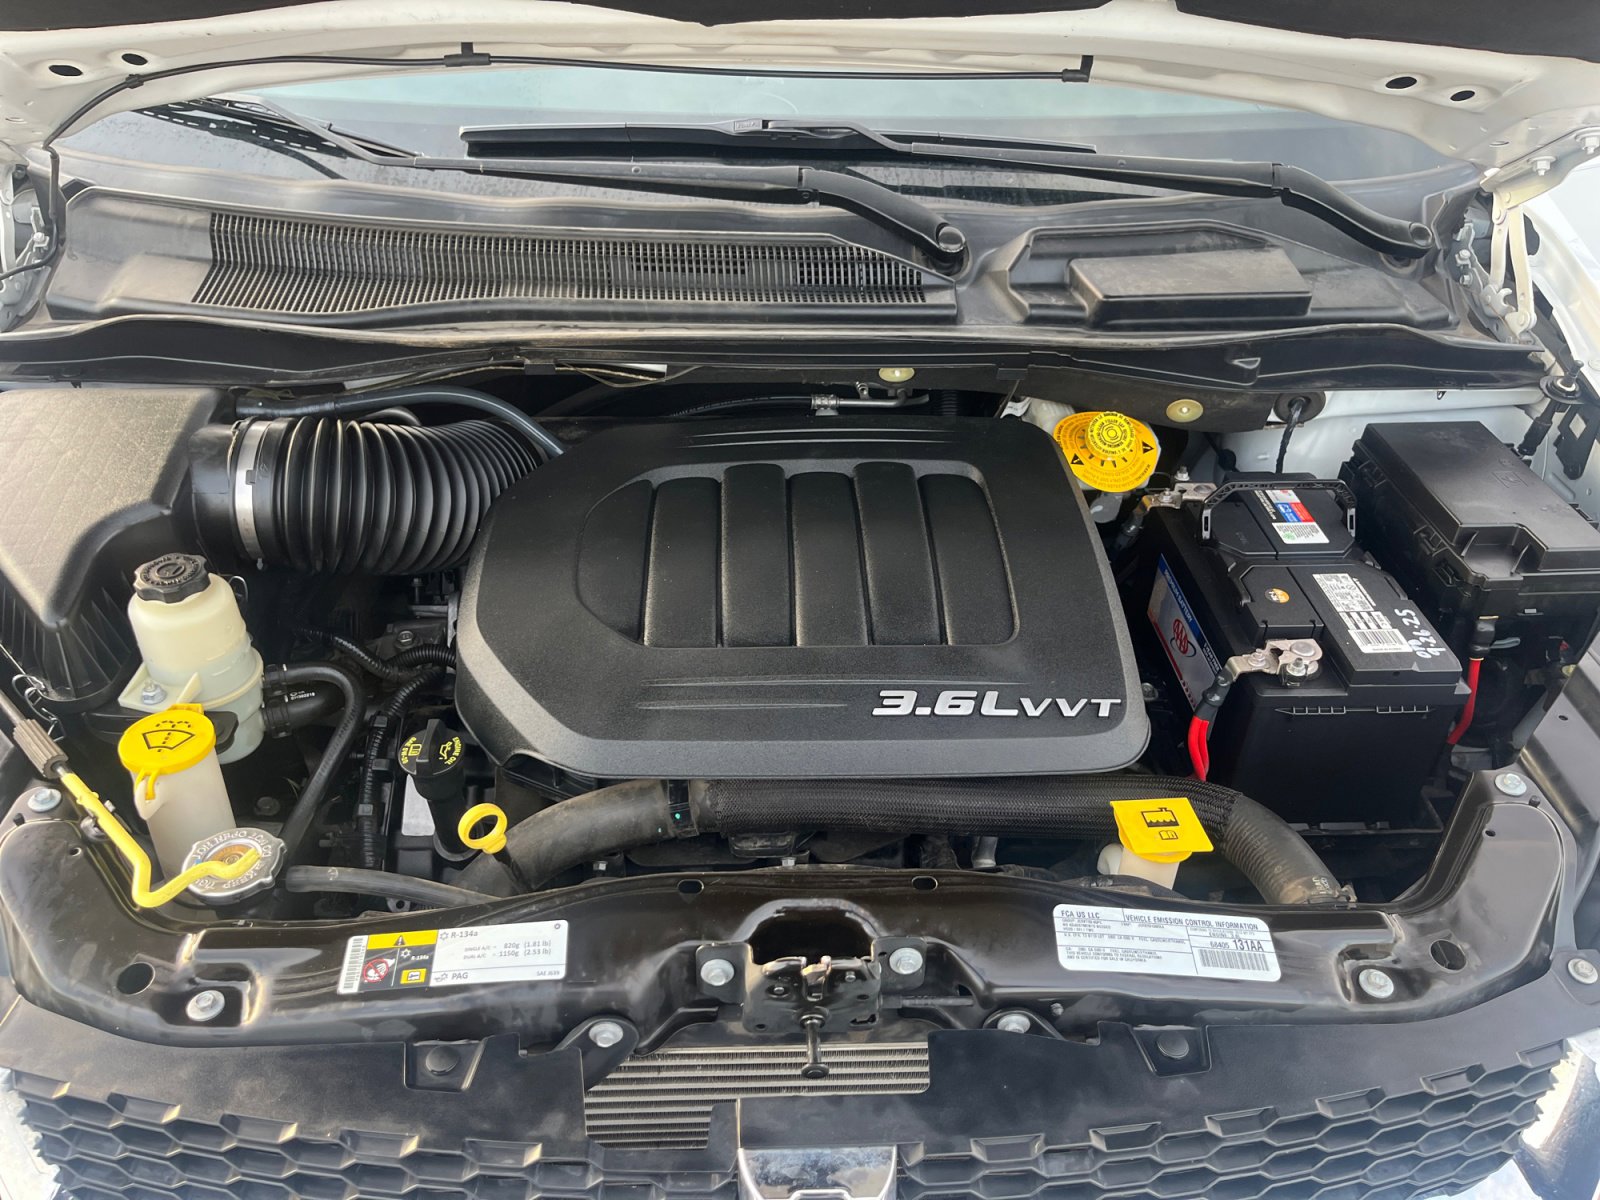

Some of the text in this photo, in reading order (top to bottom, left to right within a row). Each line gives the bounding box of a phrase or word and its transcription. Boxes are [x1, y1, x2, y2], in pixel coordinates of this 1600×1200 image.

[1177, 593, 1192, 624] BATTERY
[1174, 619, 1189, 654] AAA
[1394, 608, 1446, 656] 9.26.25
[872, 690, 1122, 717] 3.6L VVT
[405, 736, 416, 747] SAE
[444, 736, 462, 765] ENGINE OIL
[214, 830, 247, 842] OPEN
[192, 842, 214, 860] HOT
[1126, 915, 1258, 930] VEHICLE EMISSION CONTROL INFORMATION
[451, 930, 478, 939] R-134a
[1232, 939, 1264, 951] 131AA
